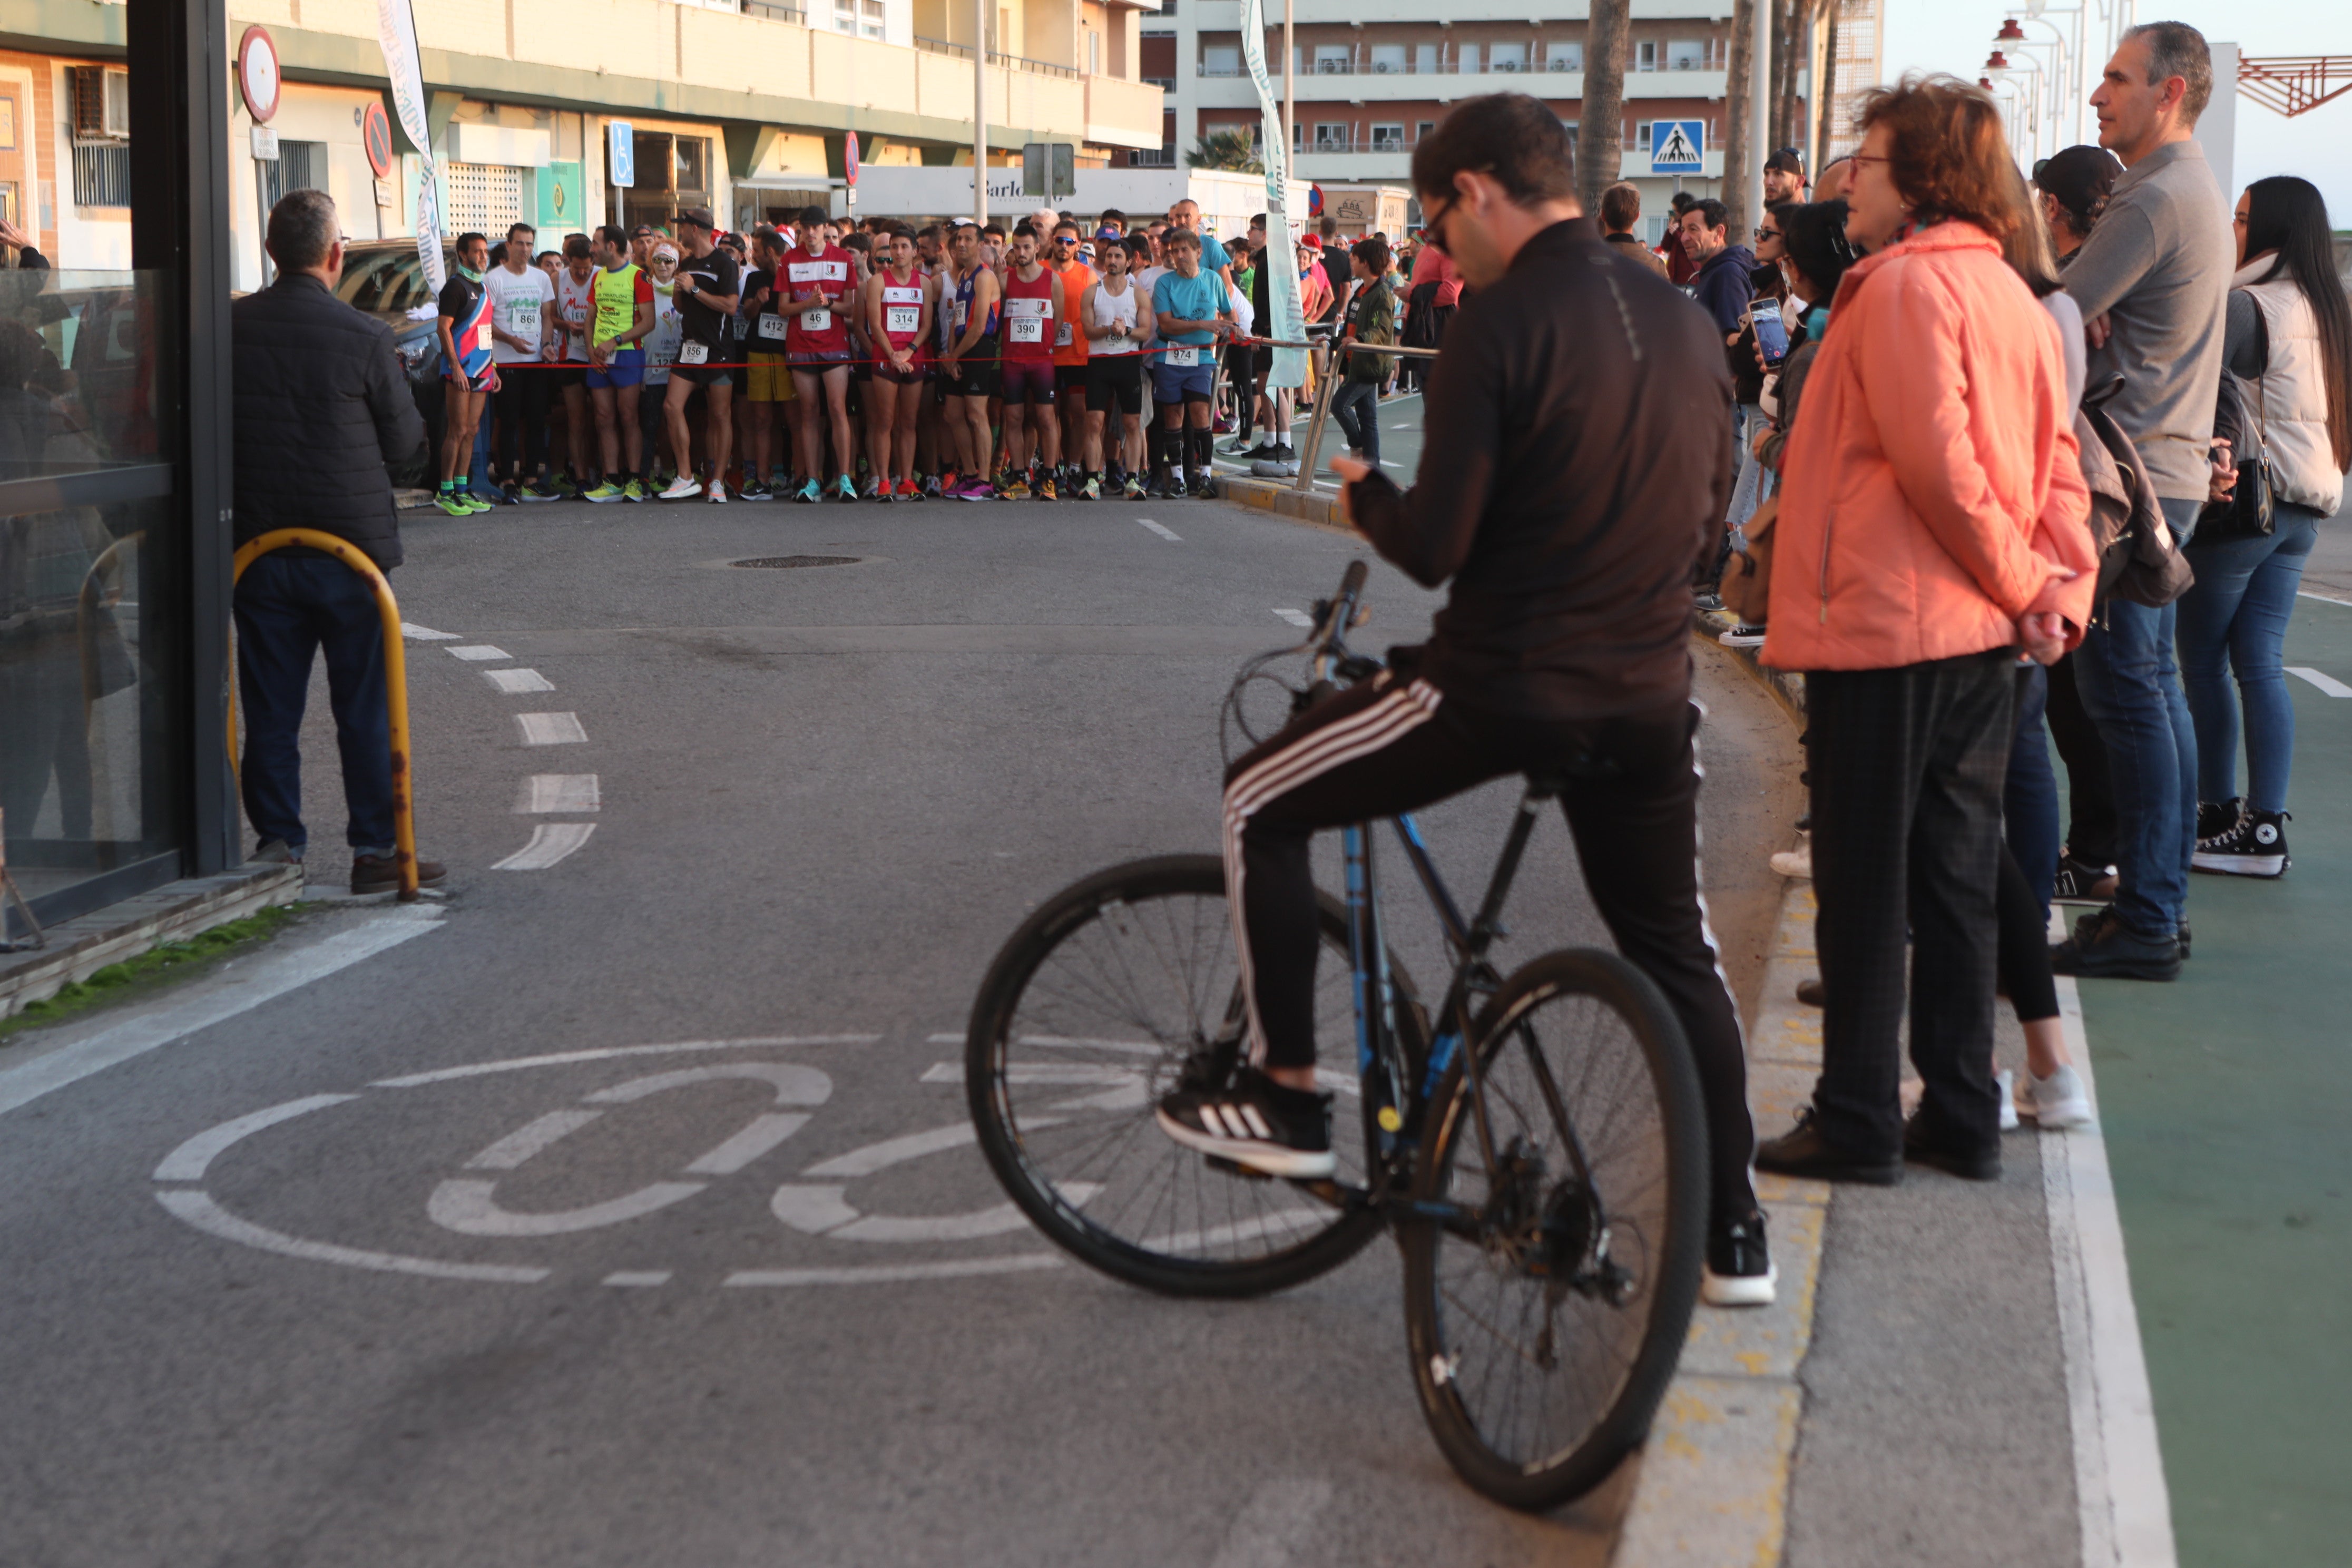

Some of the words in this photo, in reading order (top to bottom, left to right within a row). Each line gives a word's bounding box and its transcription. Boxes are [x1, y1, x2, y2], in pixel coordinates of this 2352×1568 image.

[809, 313, 821, 323] 46
[895, 315, 913, 324] 314
[765, 321, 782, 332] 412
[1017, 325, 1035, 334] 390
[687, 346, 701, 356] 856
[1173, 348, 1191, 359] 974
